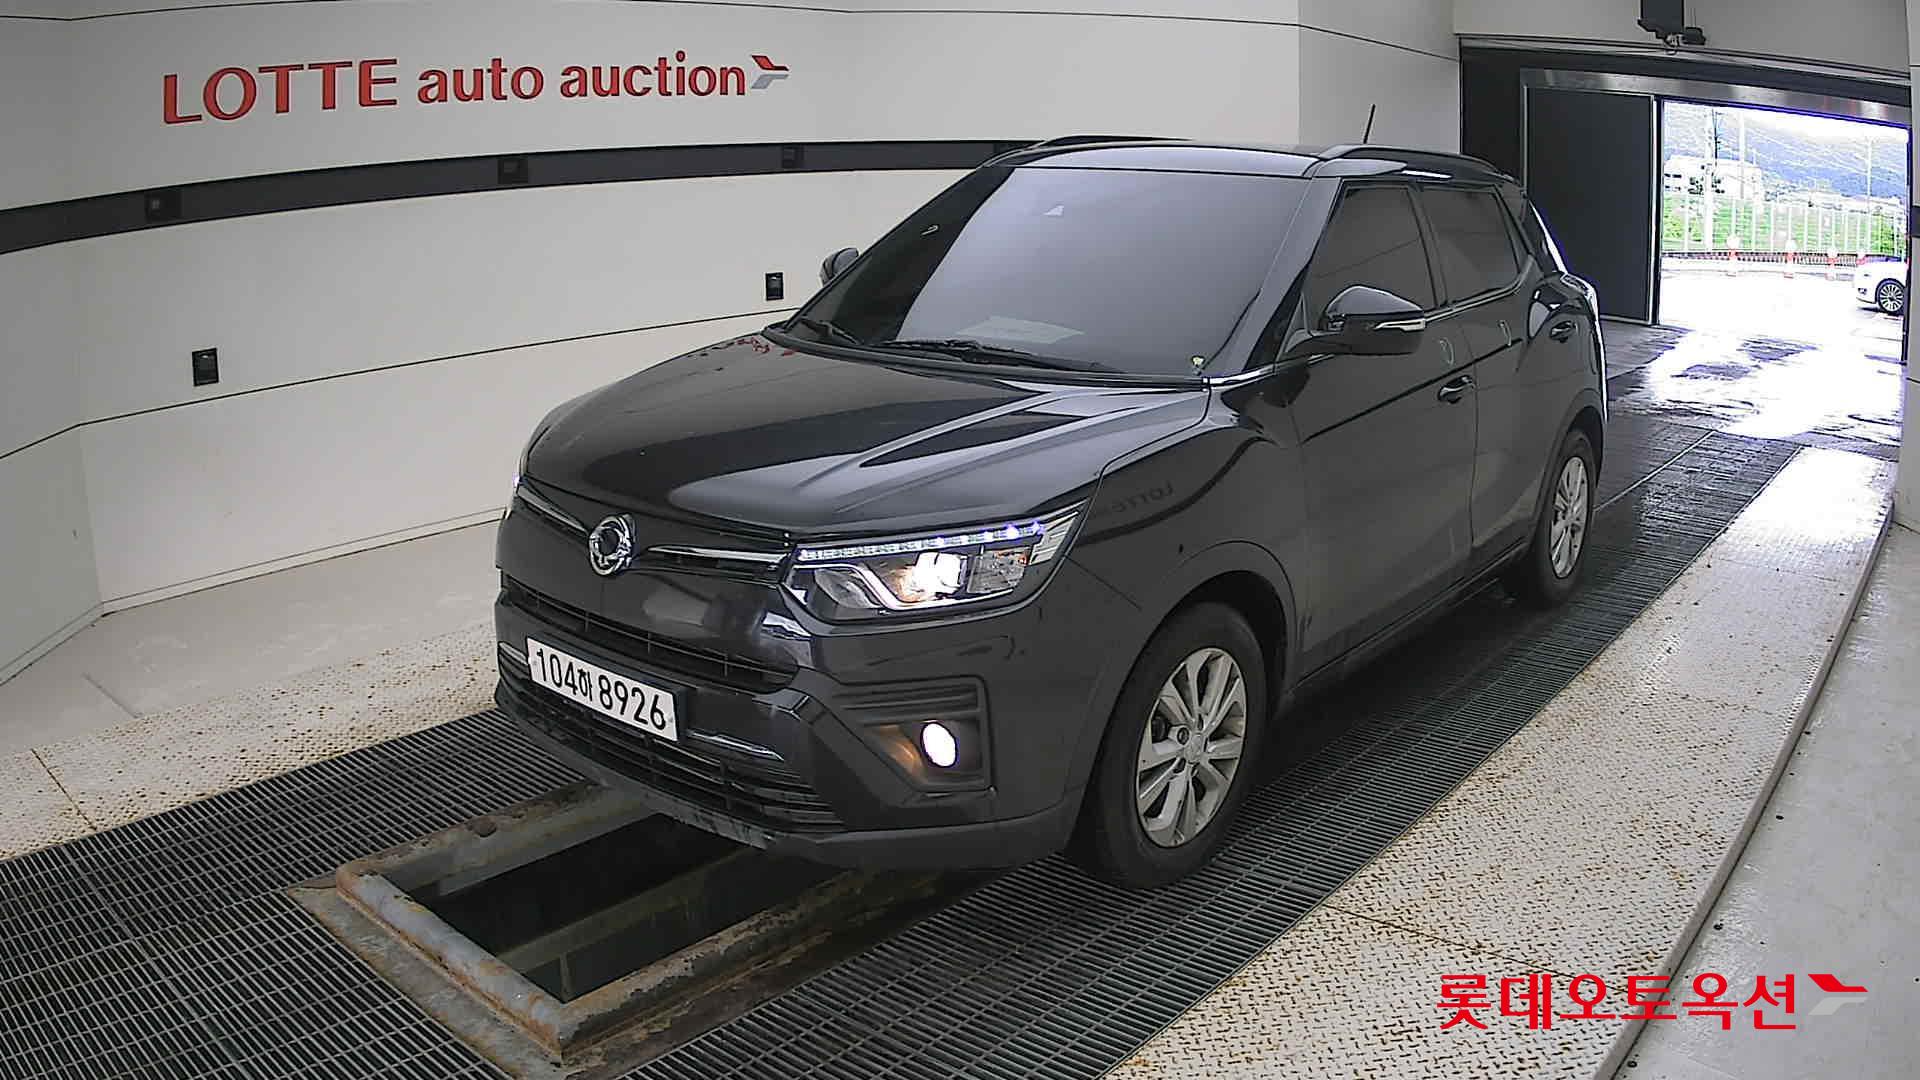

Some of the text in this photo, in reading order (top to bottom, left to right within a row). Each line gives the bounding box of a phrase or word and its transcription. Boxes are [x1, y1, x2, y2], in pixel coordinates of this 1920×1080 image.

[163, 49, 747, 125] LOTTE auto auction
[536, 647, 667, 731] 104하 8926
